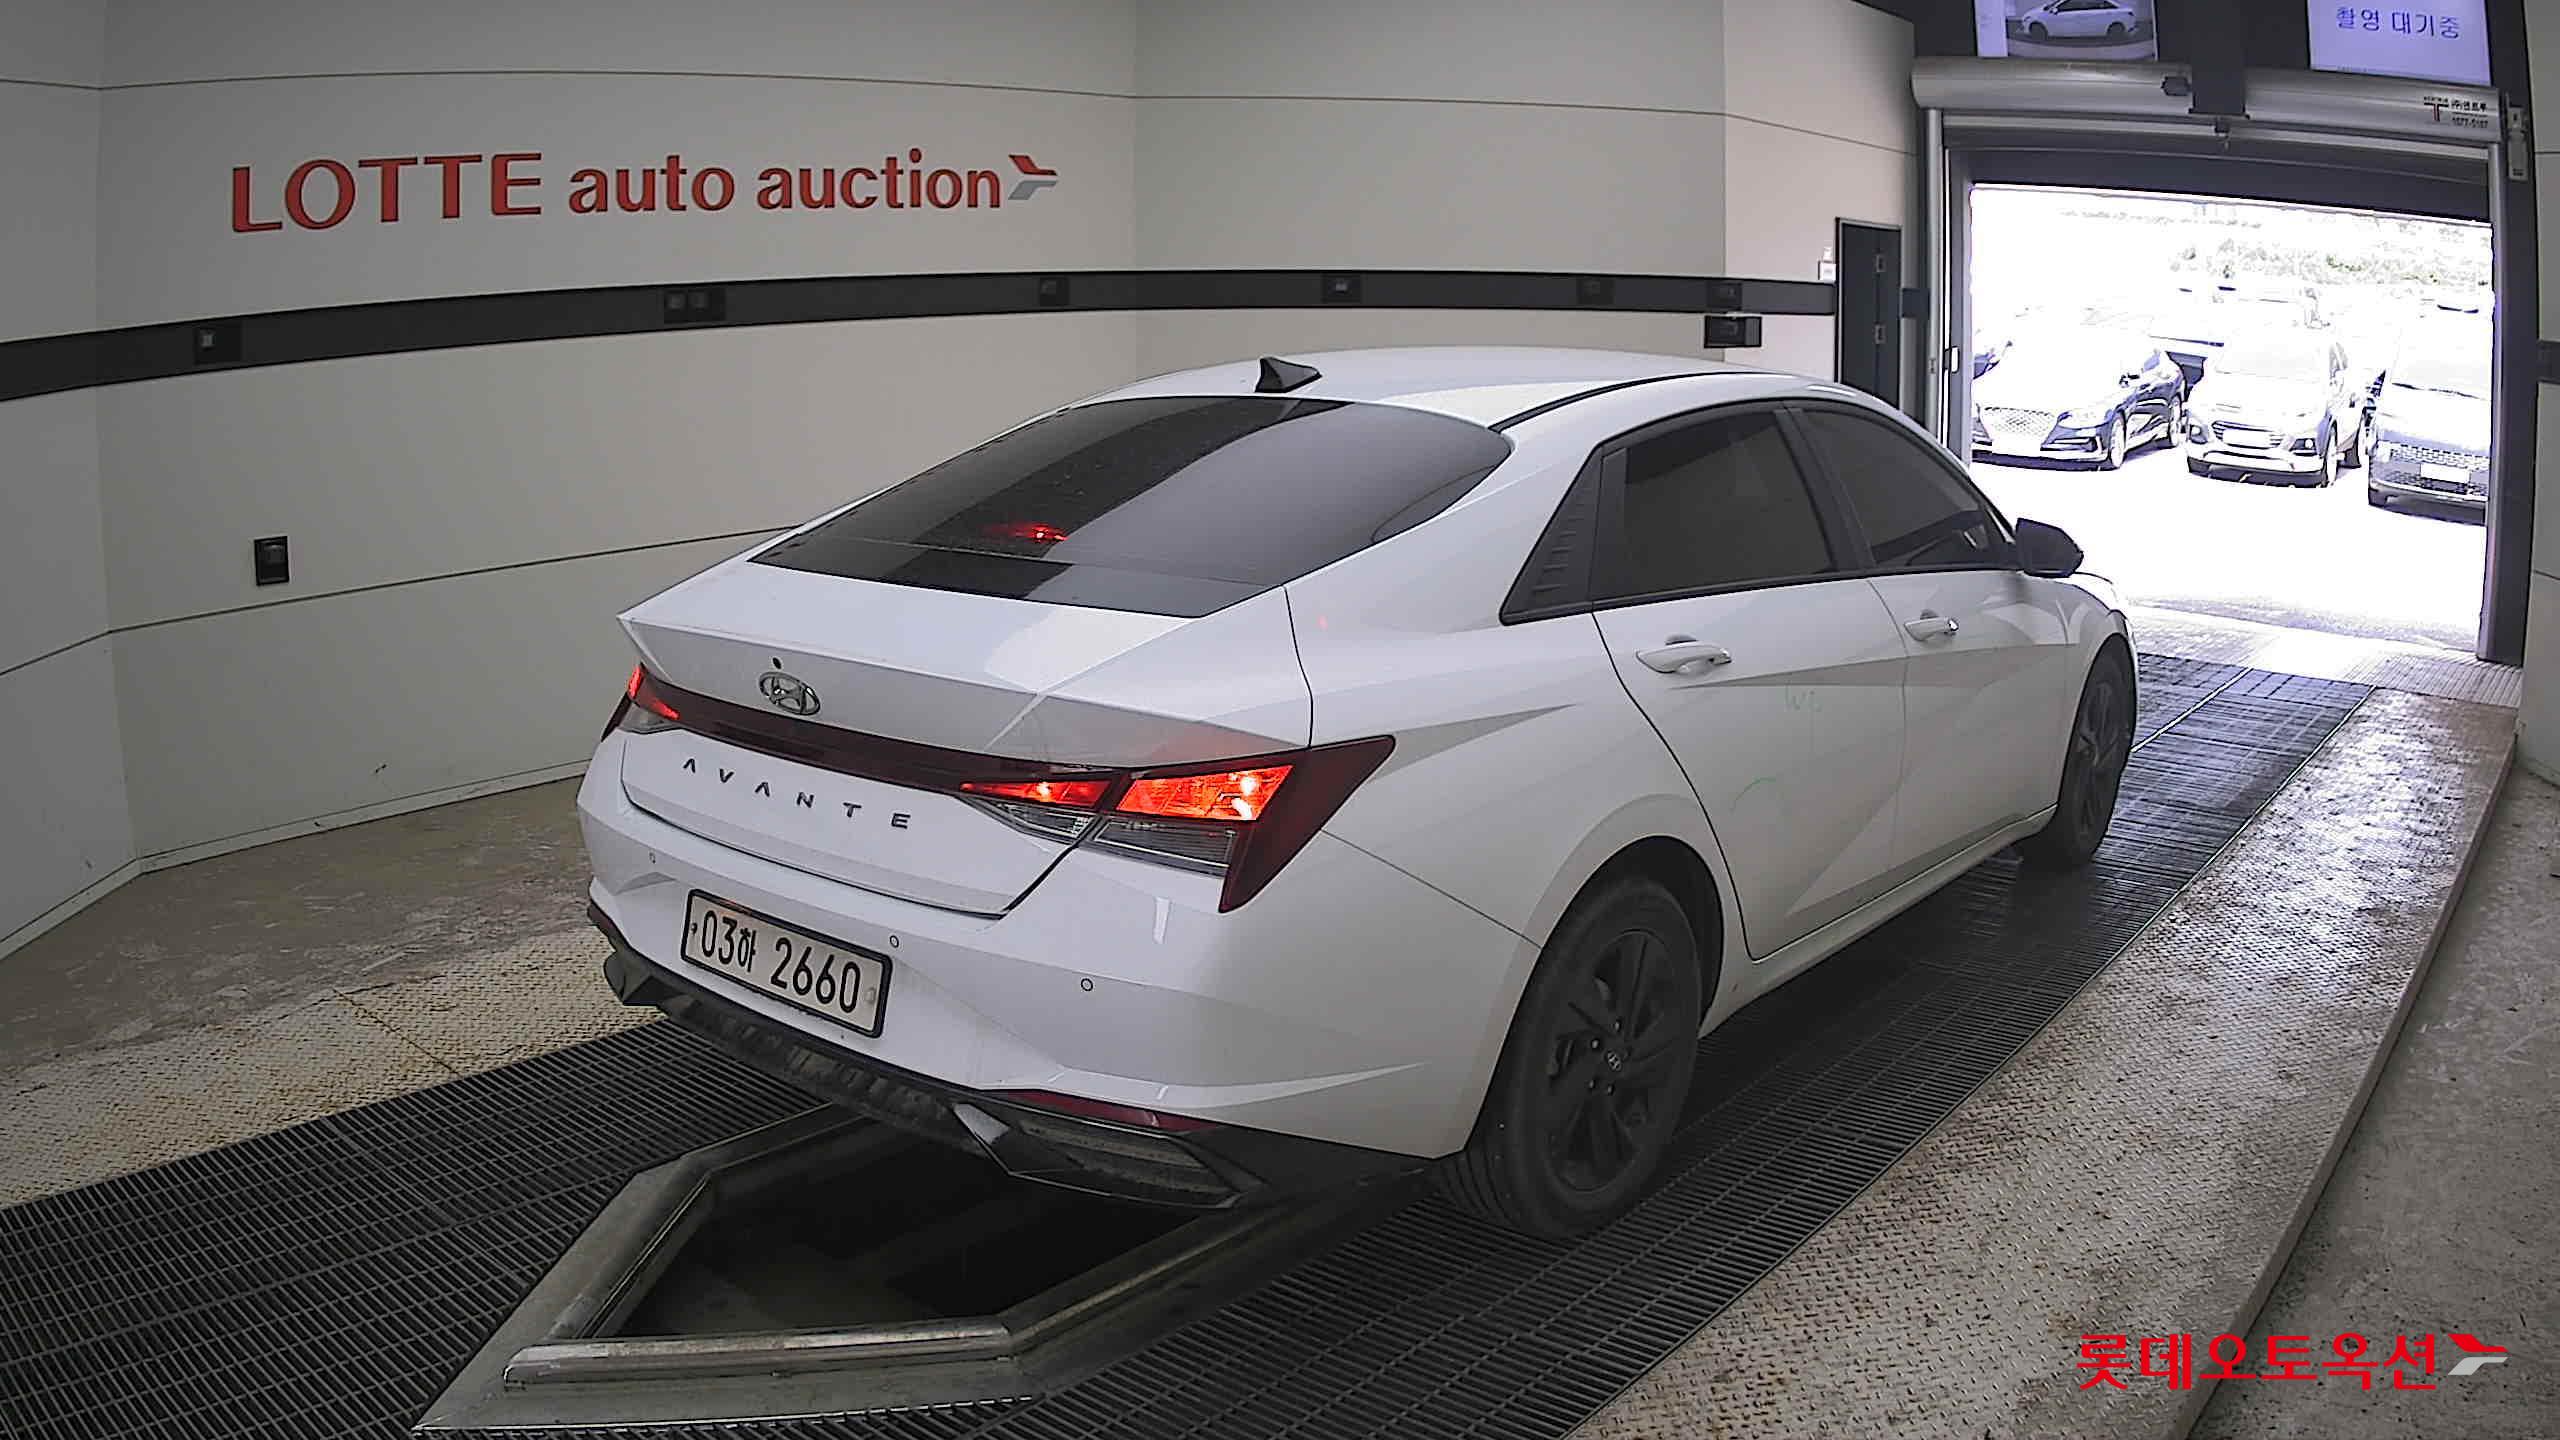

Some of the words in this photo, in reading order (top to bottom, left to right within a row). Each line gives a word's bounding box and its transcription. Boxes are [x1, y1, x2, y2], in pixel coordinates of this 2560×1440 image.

[2336, 6, 2381, 32] 촬영
[2391, 11, 2461, 40] 대기중
[233, 152, 541, 232] LOTTE
[570, 156, 736, 213] auto
[758, 149, 1002, 210] auction
[683, 757, 911, 829] AVANTE
[701, 910, 757, 973] 03하
[770, 937, 861, 1013] 2660
